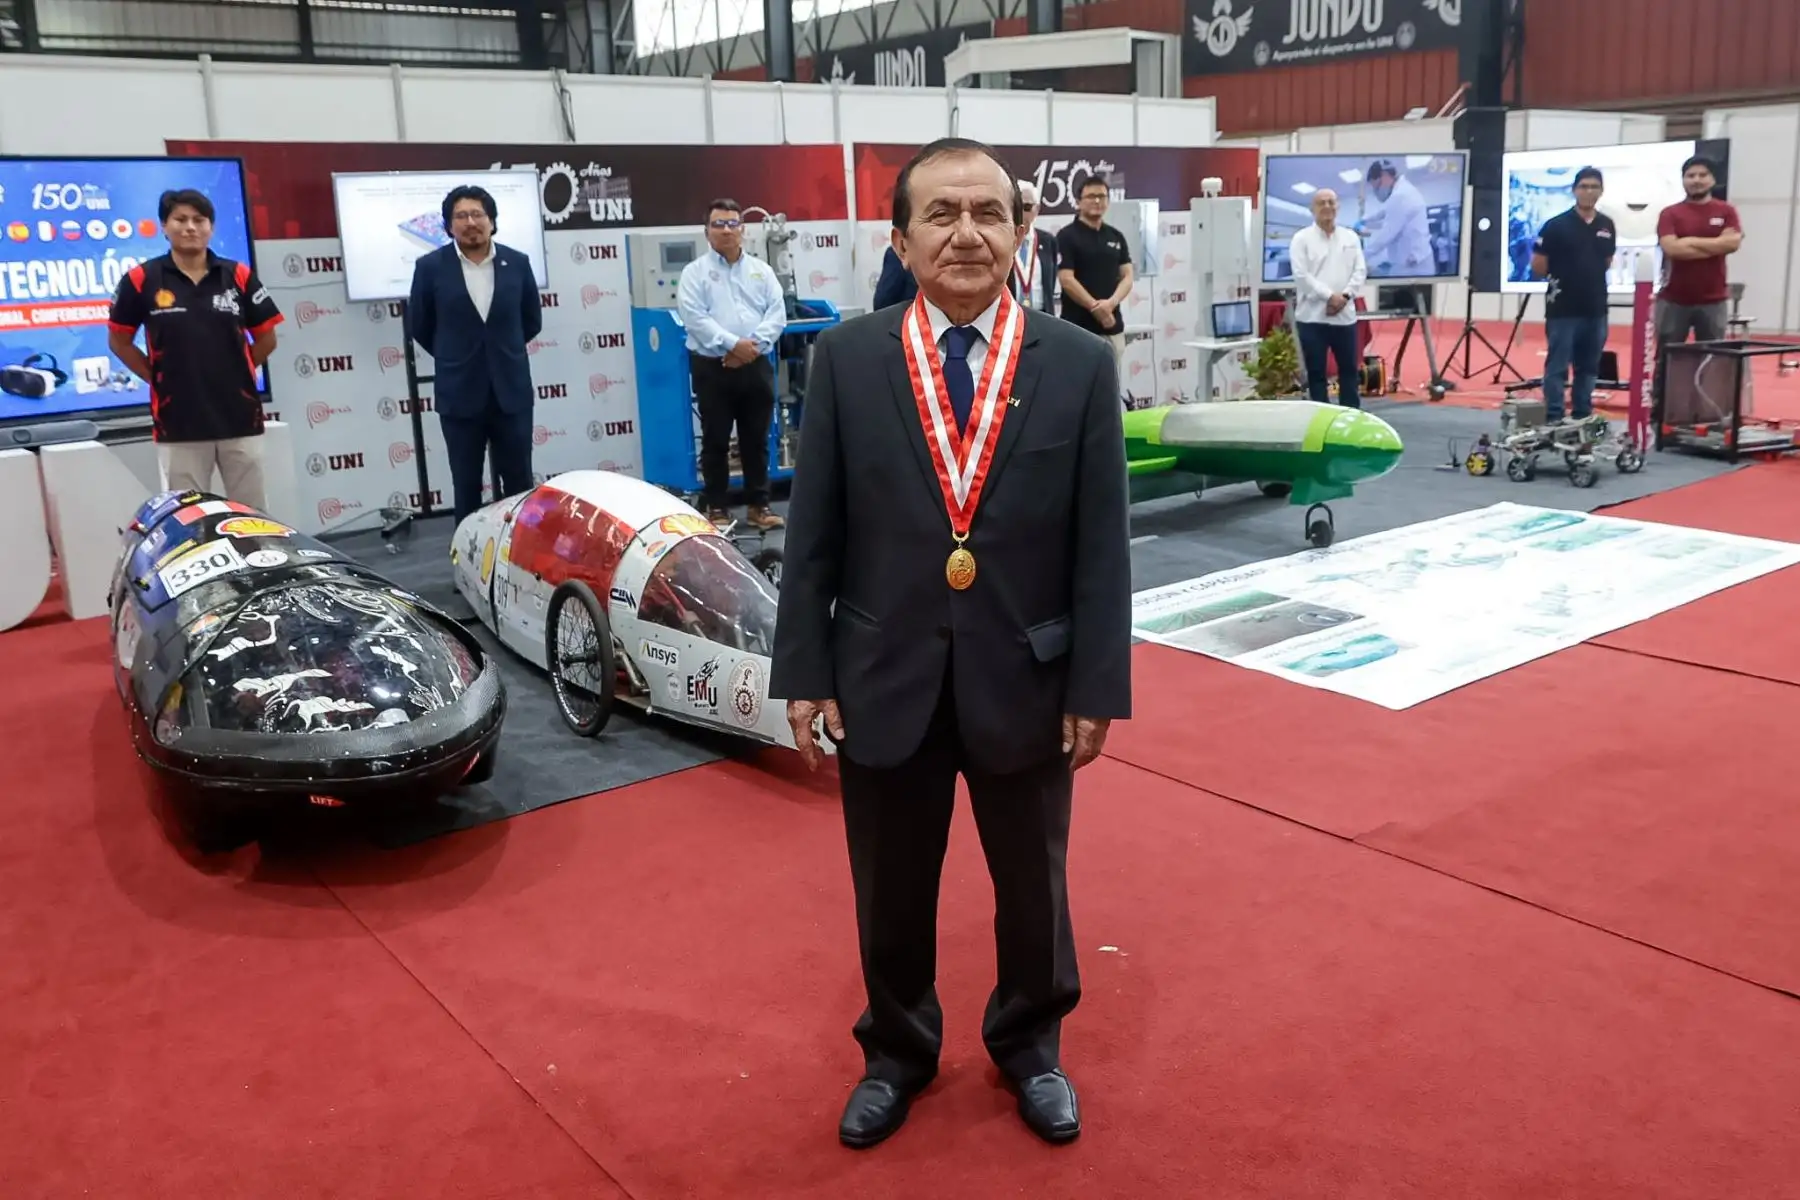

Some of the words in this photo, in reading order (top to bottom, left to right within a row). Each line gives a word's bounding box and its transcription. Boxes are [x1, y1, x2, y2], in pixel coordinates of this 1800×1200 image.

[32, 183, 82, 211] 150
[588, 198, 634, 221] UNI
[815, 235, 840, 248] UNI
[589, 245, 618, 260] UNI
[0, 248, 148, 299] TECNOLÓ
[306, 257, 343, 273] UNI
[541, 293, 559, 308] NI
[597, 333, 626, 349] UNI
[318, 355, 354, 373] UNI
[537, 384, 568, 400] UNI
[399, 397, 433, 415] UI
[606, 420, 634, 437] UNI
[329, 452, 365, 470] UNI
[409, 491, 442, 508] UI
[171, 553, 231, 588] 330
[641, 641, 677, 670] Ansys
[687, 675, 717, 707] EMU
